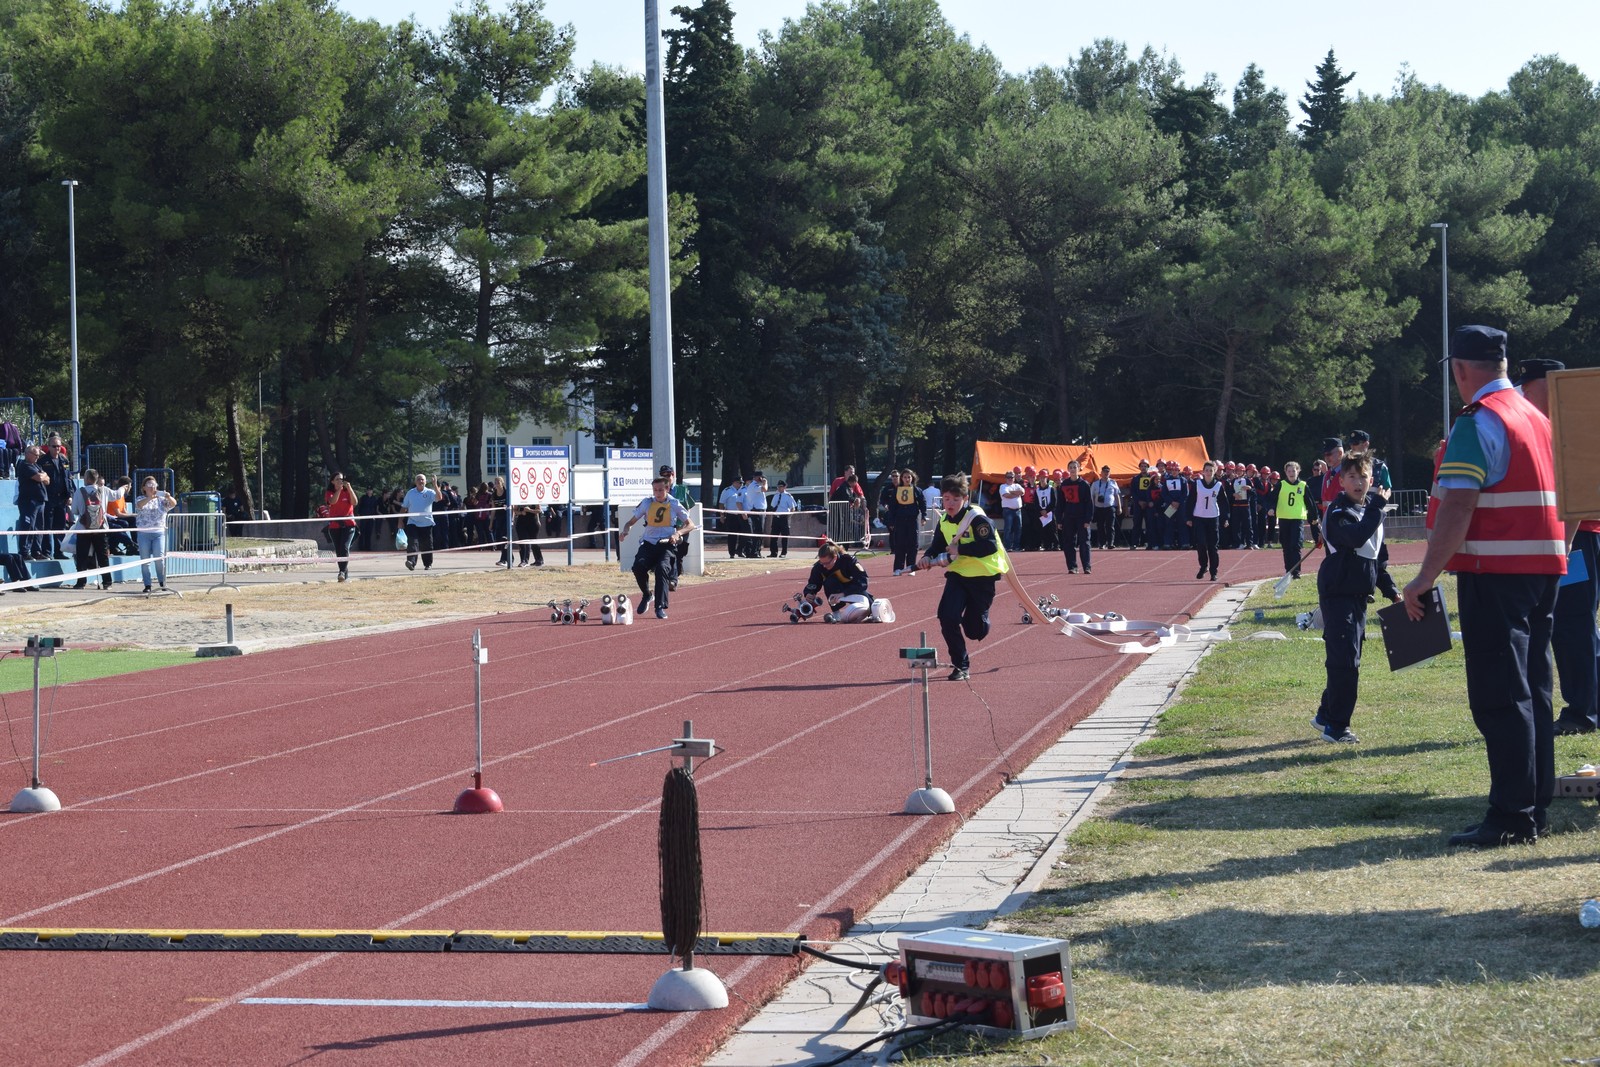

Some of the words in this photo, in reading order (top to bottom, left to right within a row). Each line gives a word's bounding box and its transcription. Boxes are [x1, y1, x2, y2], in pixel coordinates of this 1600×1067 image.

[1143, 478, 1150, 488] 9
[1171, 481, 1177, 489] 1
[901, 489, 909, 502] 8
[1288, 491, 1295, 507] 6
[1204, 496, 1209, 510] 1
[654, 506, 666, 523] 9
